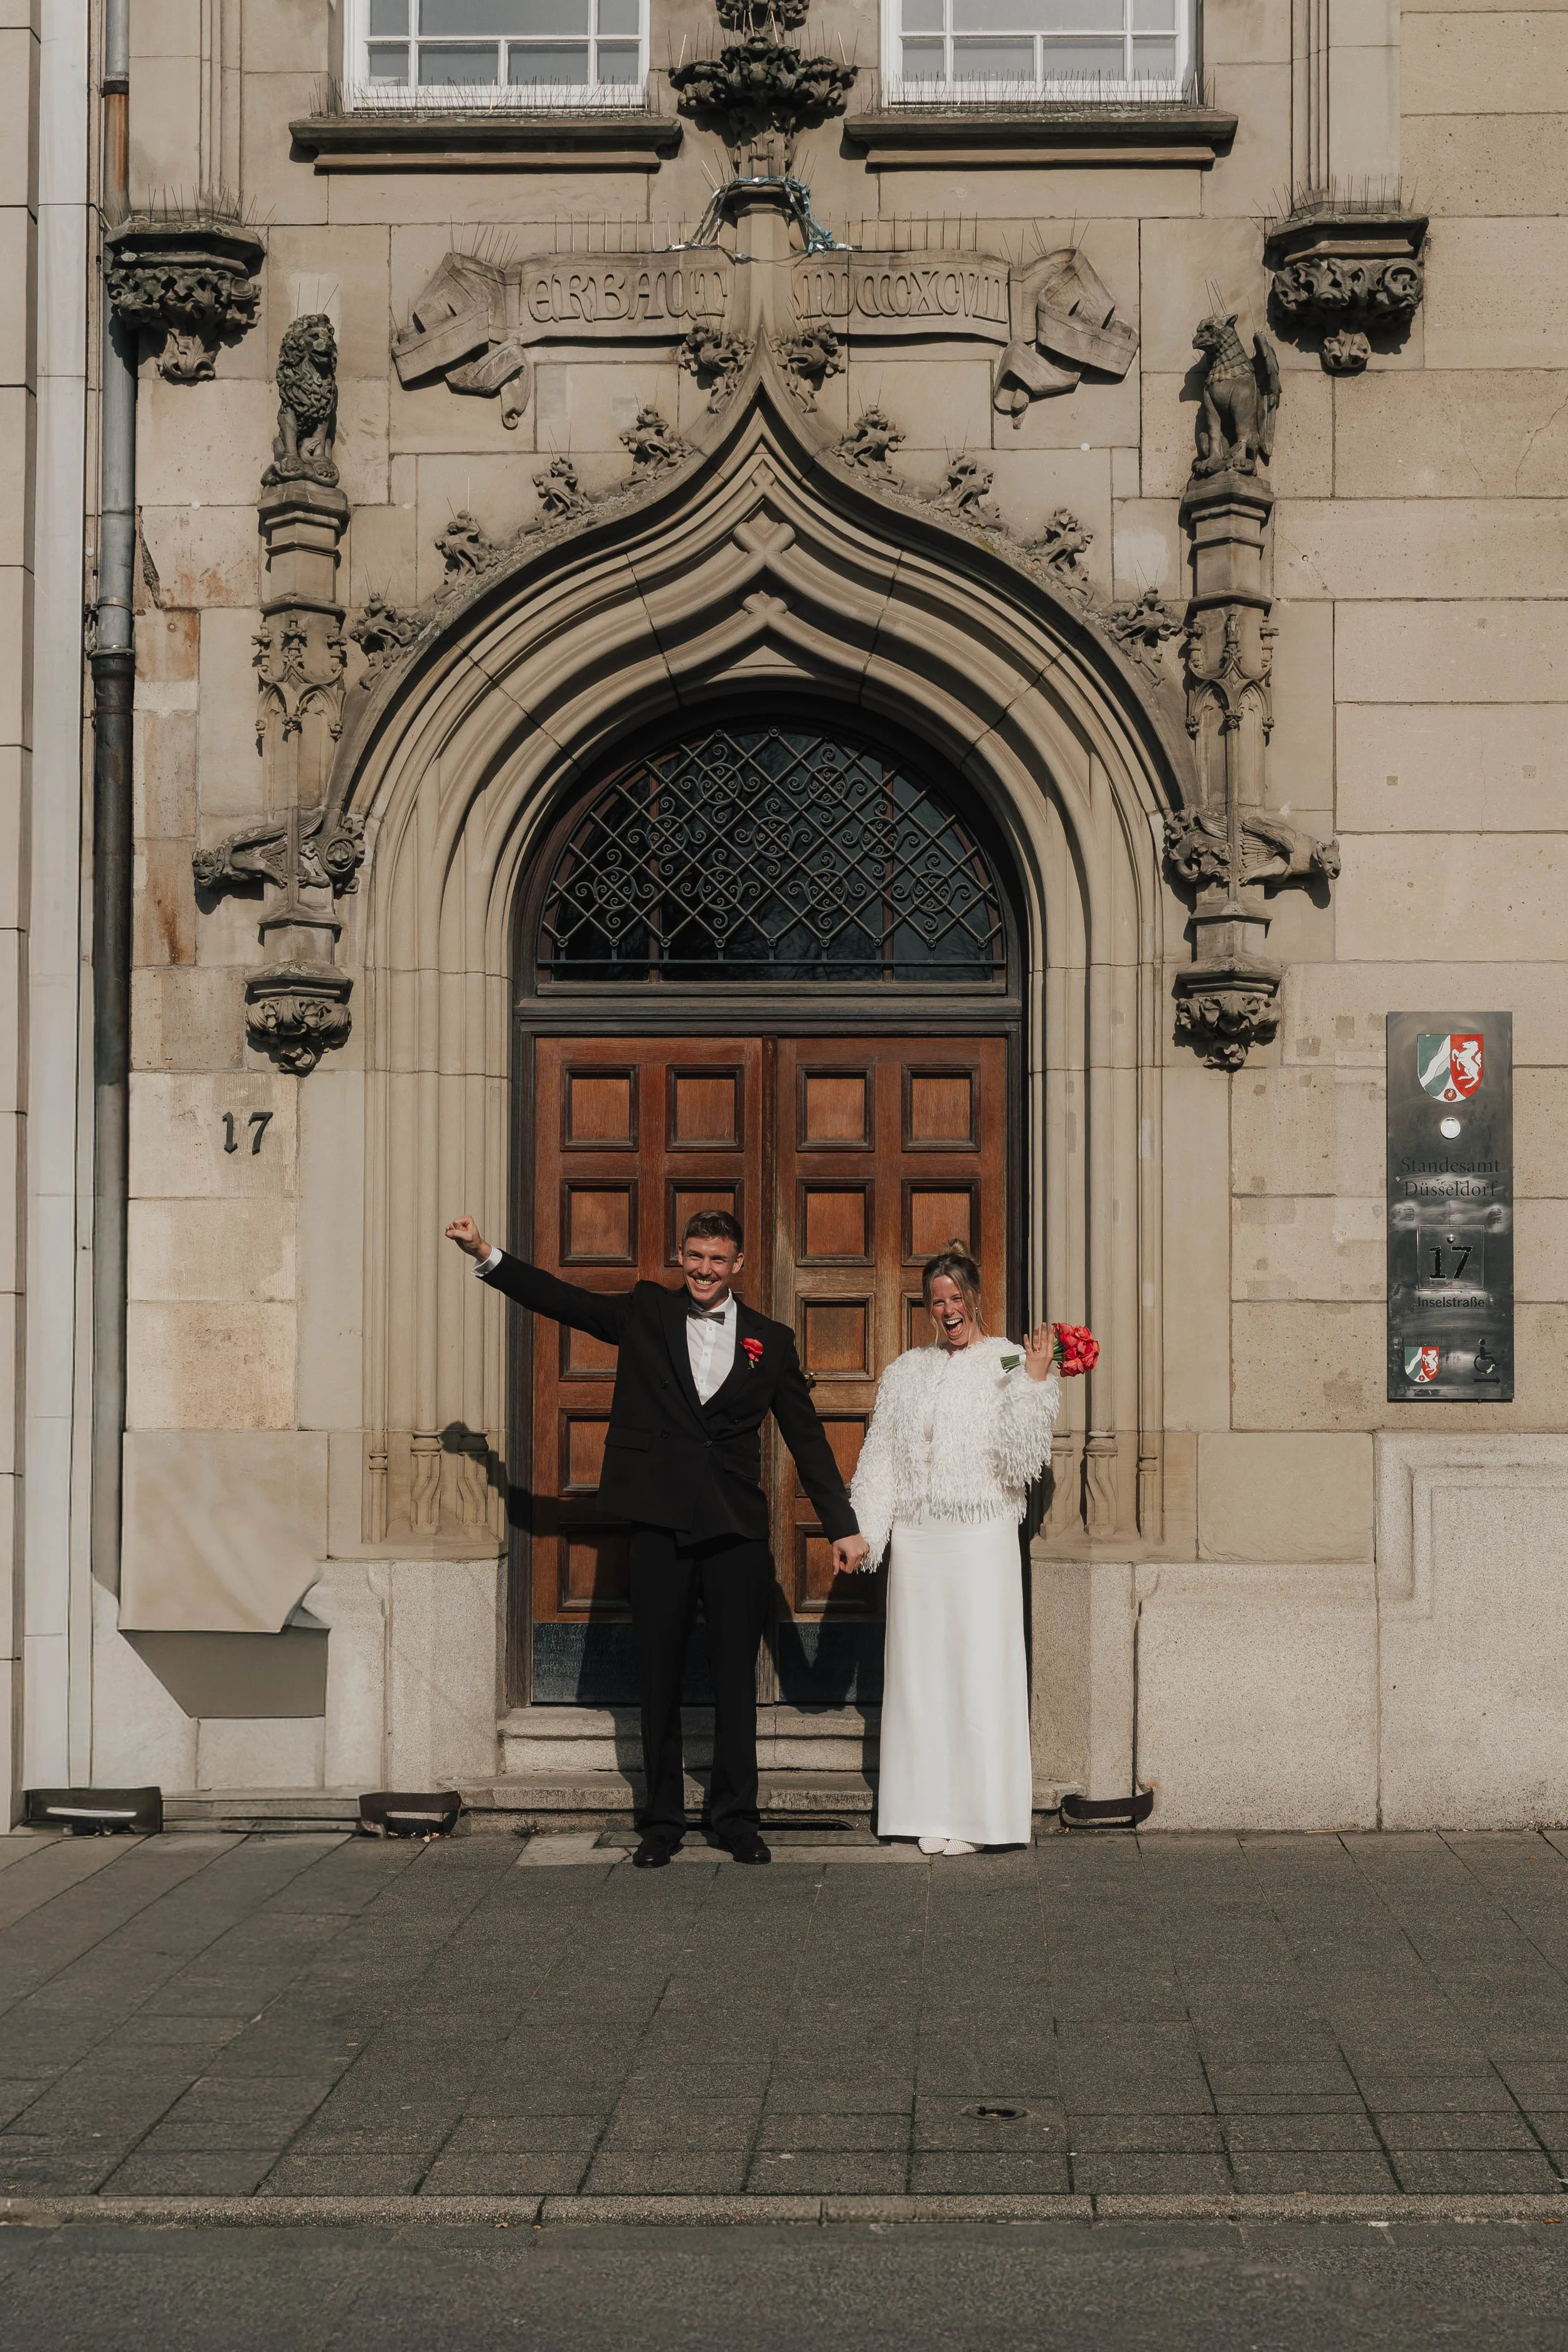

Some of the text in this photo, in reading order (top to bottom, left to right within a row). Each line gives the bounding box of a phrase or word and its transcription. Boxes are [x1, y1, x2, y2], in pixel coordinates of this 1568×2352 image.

[528, 269, 728, 323] ERBAUT
[222, 1111, 273, 1155] 17
[1401, 1157, 1500, 1172] Standesamt
[1404, 1180, 1498, 1196] Düsseldorf
[1429, 1246, 1473, 1279] 17
[1417, 1296, 1485, 1307] Inselstraße
